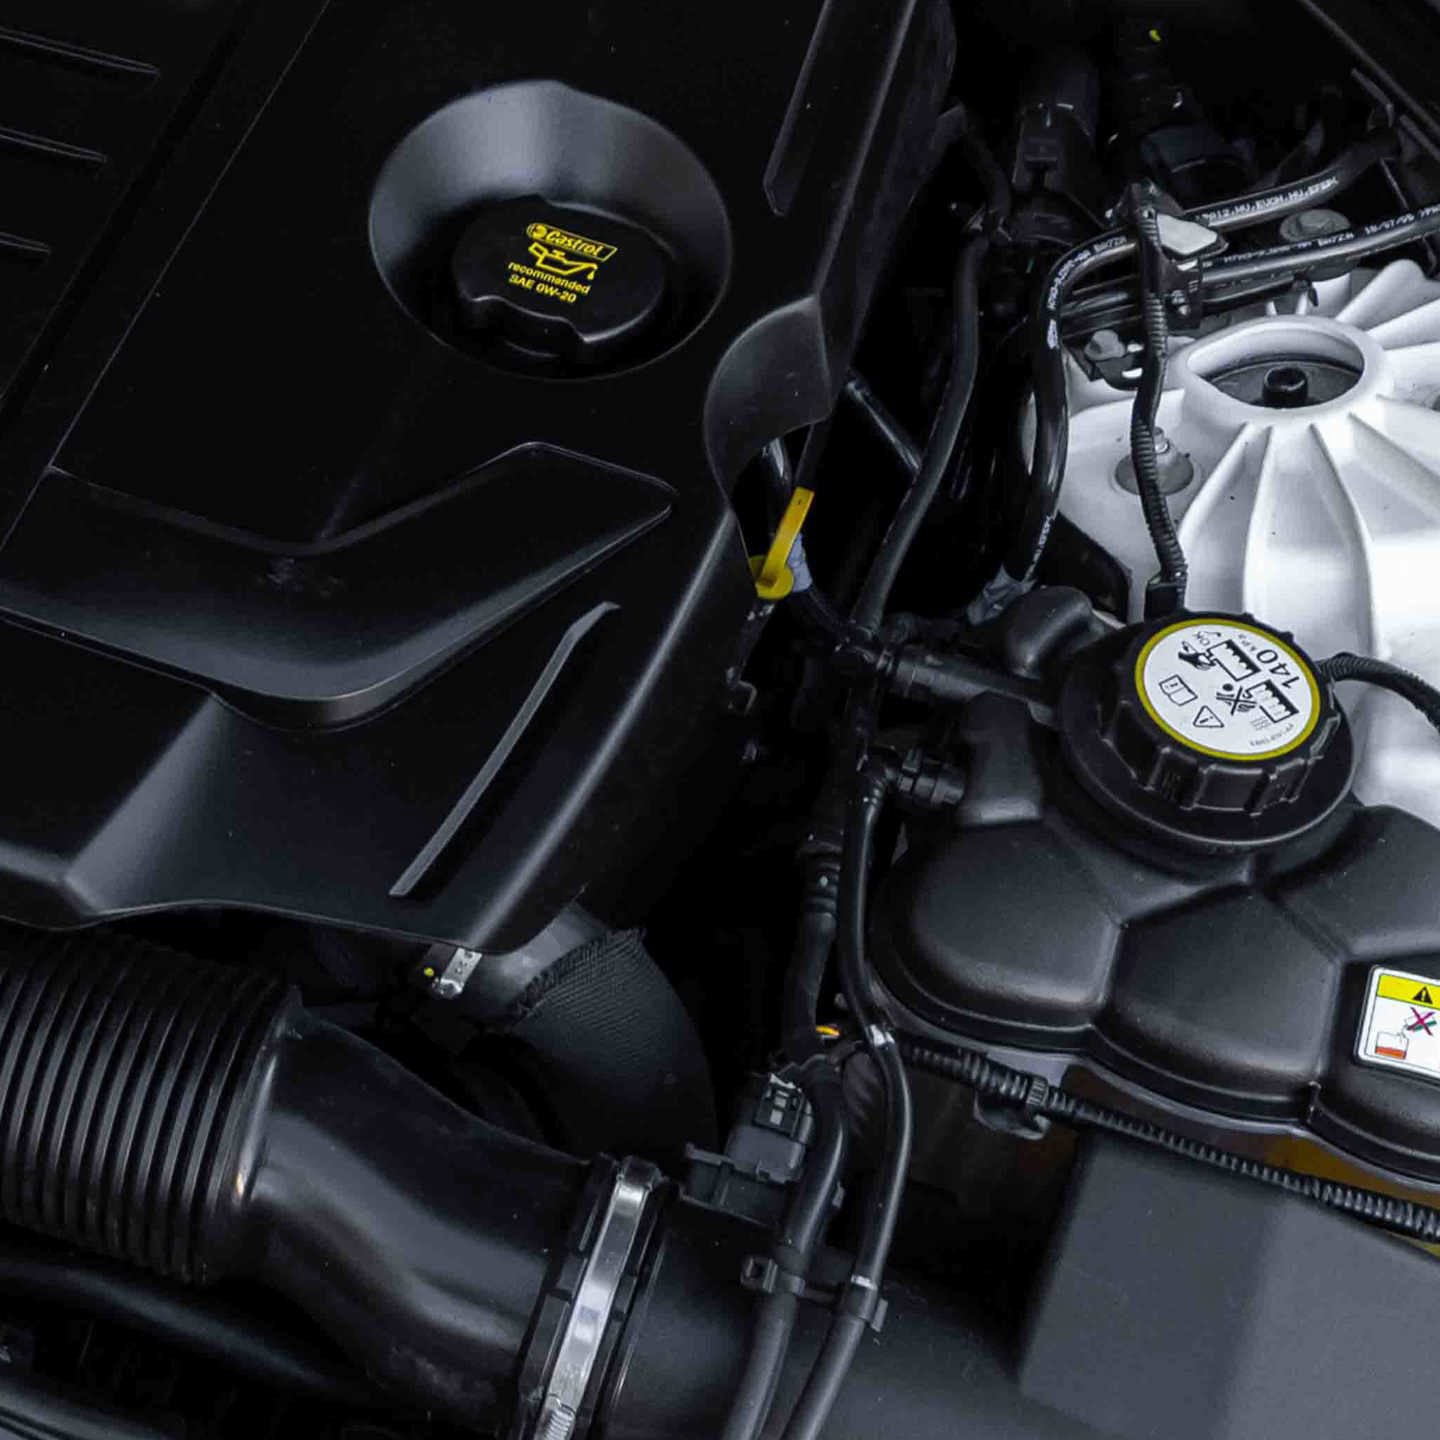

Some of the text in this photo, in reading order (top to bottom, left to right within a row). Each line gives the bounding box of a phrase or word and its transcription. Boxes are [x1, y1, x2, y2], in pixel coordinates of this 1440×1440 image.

[545, 230, 604, 256] Castrol
[507, 261, 591, 295] recommended
[508, 273, 577, 303] SAE 0W-20
[1256, 648, 1300, 689] 140
